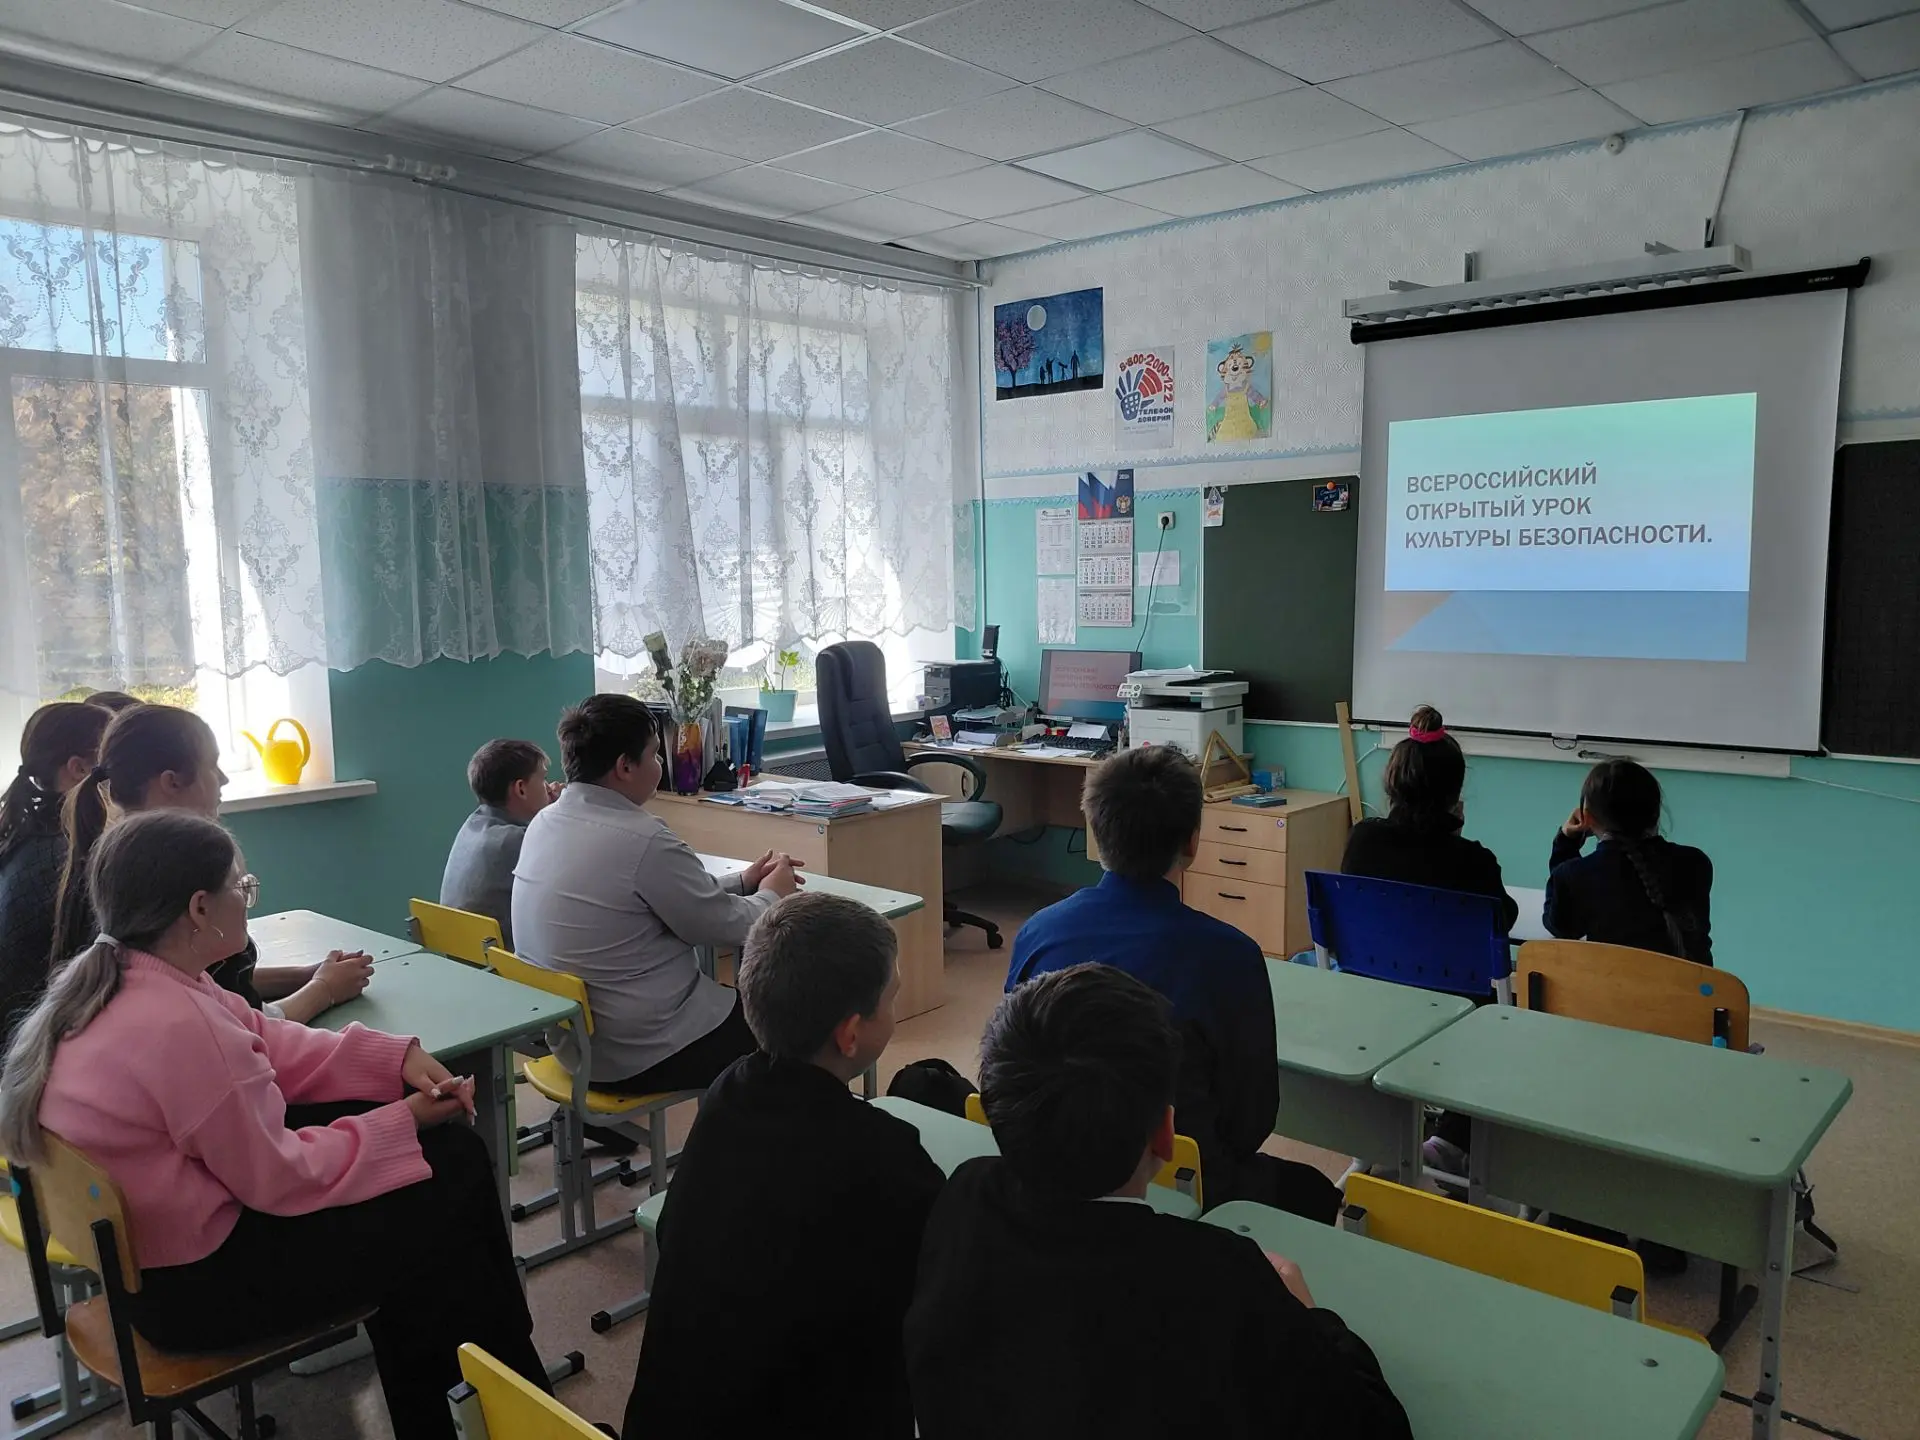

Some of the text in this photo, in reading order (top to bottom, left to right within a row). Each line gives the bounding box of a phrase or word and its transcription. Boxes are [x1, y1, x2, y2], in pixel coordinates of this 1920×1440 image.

[1139, 407, 1173, 415] ТЕЛЕФОН
[1407, 462, 1597, 493] ВСЕРОССИЙСКИЙ
[1405, 494, 1592, 520] ОТКРЫТЫЙ УРОК
[1405, 524, 1713, 548] КУЛЬТУРЫ БЕЗОПАСНОСТИ.
